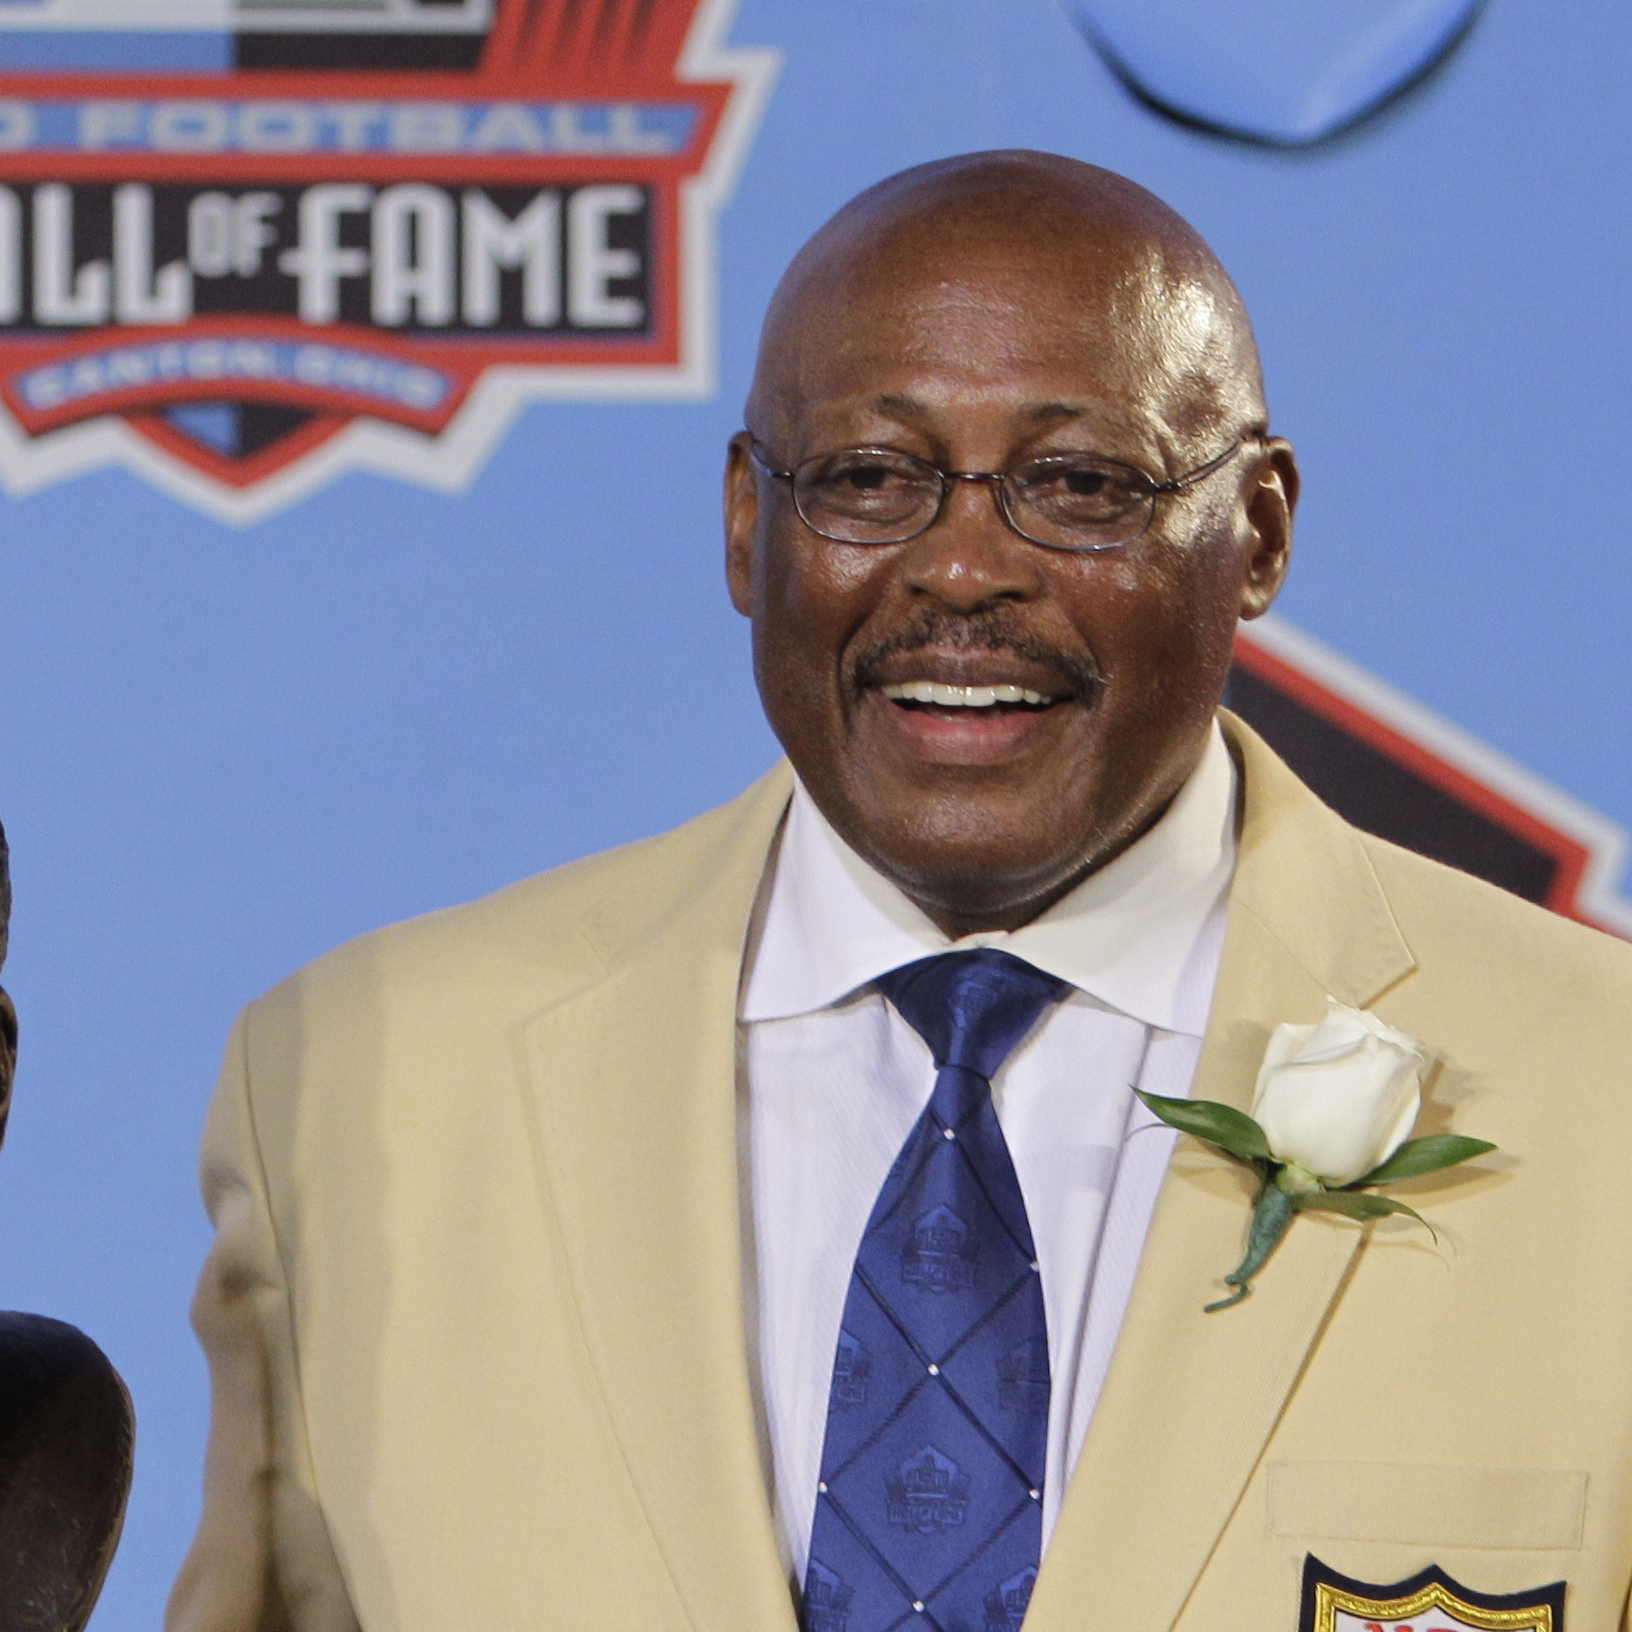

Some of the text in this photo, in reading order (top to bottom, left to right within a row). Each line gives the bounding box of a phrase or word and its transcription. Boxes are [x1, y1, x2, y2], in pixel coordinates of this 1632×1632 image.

[81, 100, 672, 153] FOOTBALL
[189, 195, 279, 276] OF
[281, 182, 645, 325] FAME
